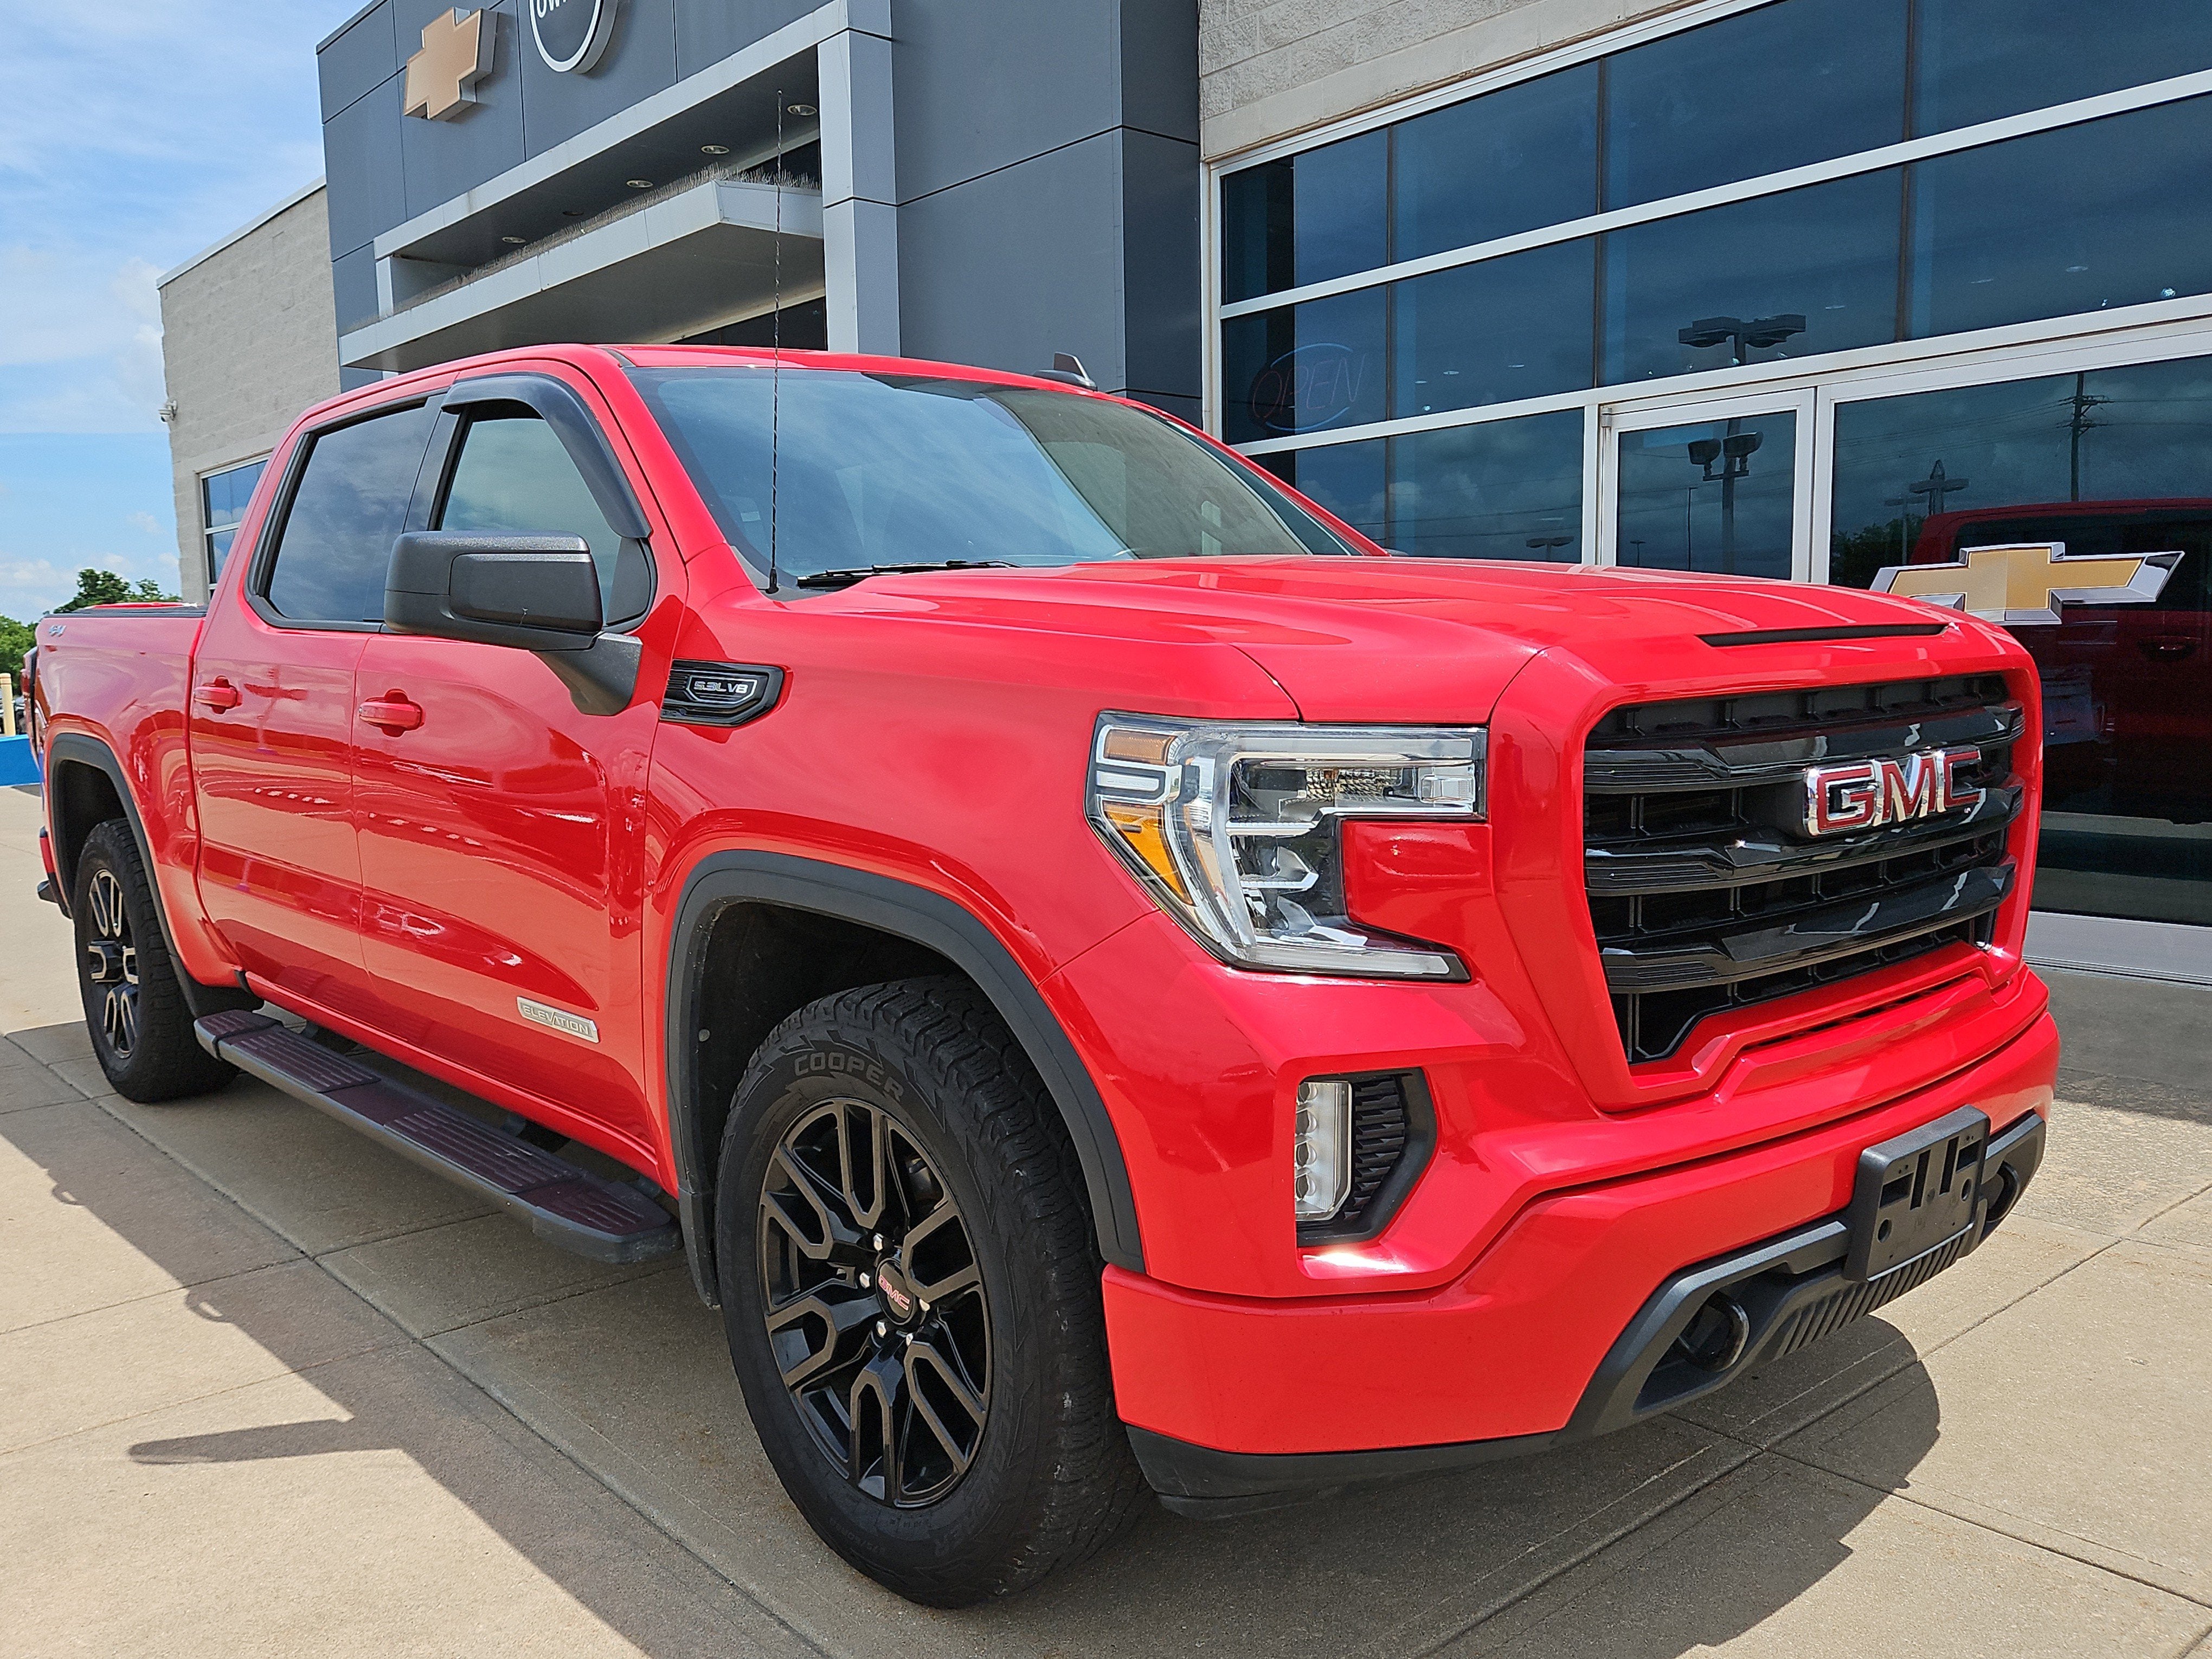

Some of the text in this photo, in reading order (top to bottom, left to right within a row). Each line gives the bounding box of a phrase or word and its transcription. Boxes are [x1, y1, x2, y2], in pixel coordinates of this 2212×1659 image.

[1252, 352, 1366, 418] OPEN
[1804, 746, 1983, 836] GMC
[524, 1006, 589, 1034] ELEVATION
[794, 1052, 904, 1102] COOPER
[878, 1275, 910, 1311] GMC
